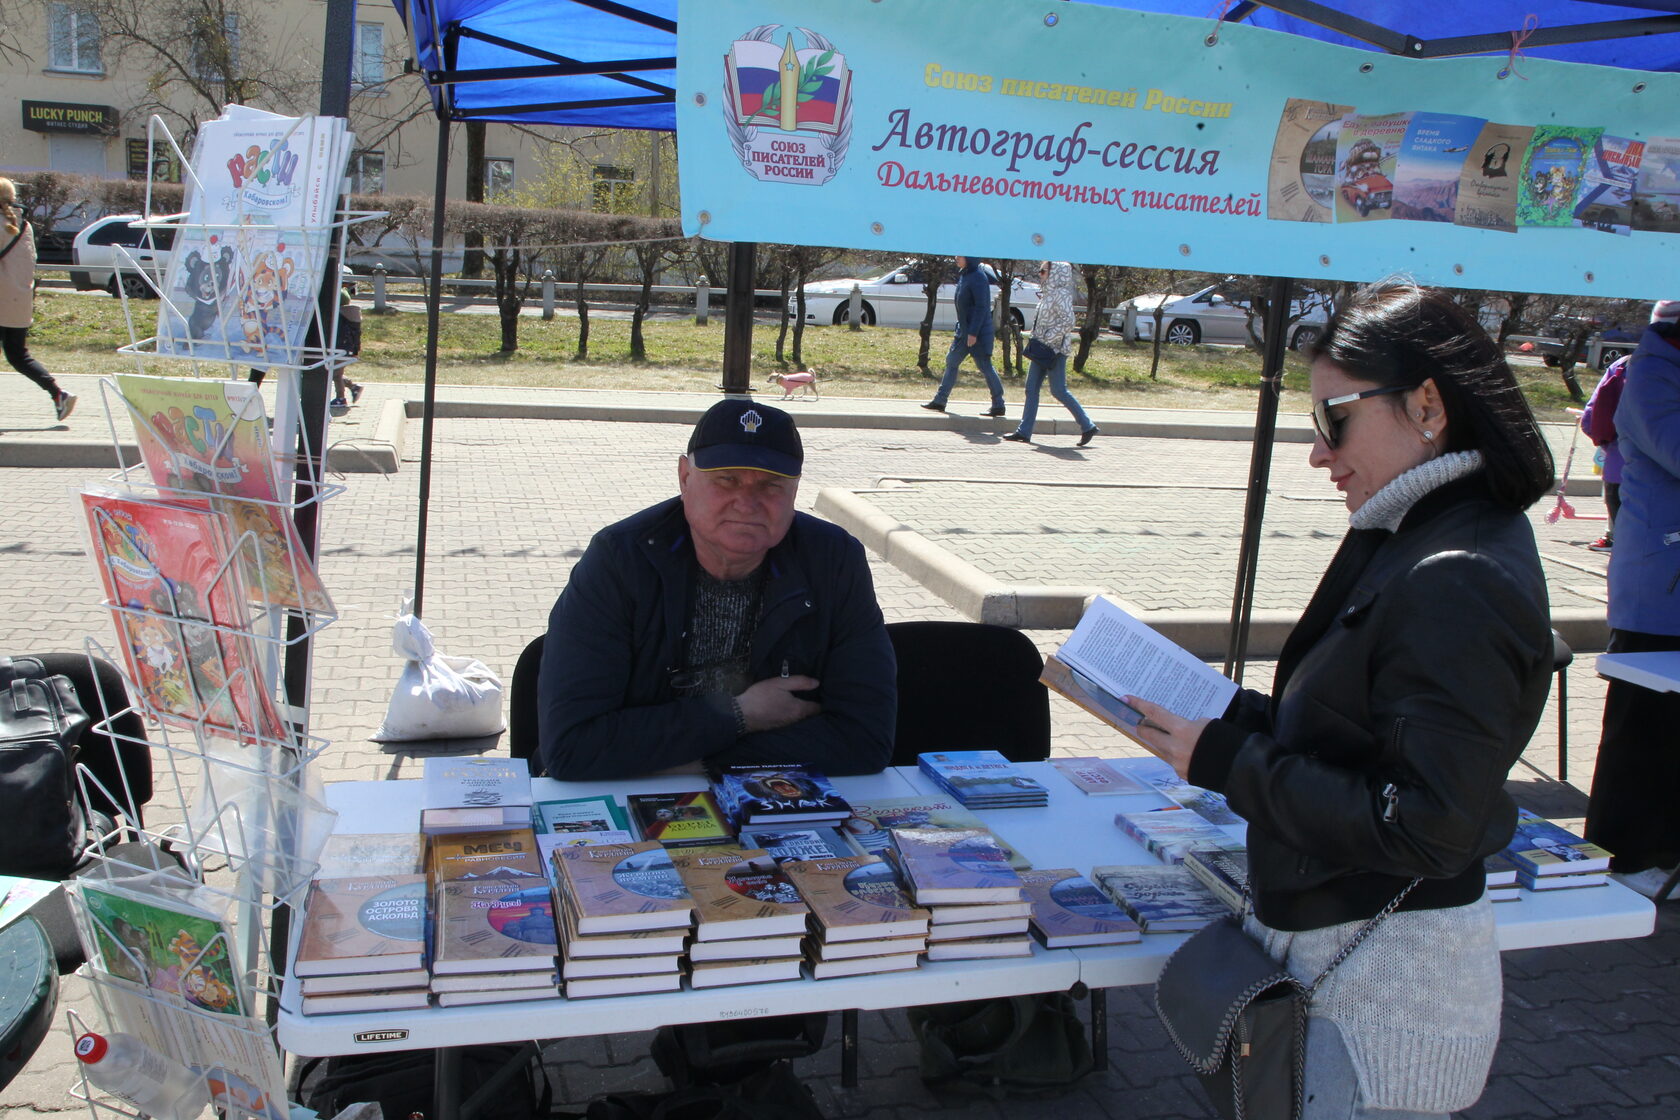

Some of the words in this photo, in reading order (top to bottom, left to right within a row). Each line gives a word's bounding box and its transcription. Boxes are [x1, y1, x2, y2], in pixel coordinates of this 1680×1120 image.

[923, 62, 992, 93] Союз
[1000, 77, 1138, 110] писателей
[1144, 88, 1234, 119] России
[30, 106, 64, 121] LUCKY
[66, 107, 103, 123] PUNCH
[770, 140, 806, 154] СОЮЗ
[871, 107, 1221, 177] Автограф-сессия
[751, 150, 826, 168] ПИСАТЕЛЕЙ
[764, 164, 814, 179] РОССИИ
[876, 160, 1129, 213] Дальневосточных
[1132, 188, 1262, 218] писателей
[463, 841, 522, 855] МЕЧ
[365, 905, 418, 915] ОСТРОВА
[372, 899, 419, 908] ЗОЛОТО
[368, 911, 419, 921] АСКОЛЬД
[361, 1031, 402, 1041] LIFETIME
